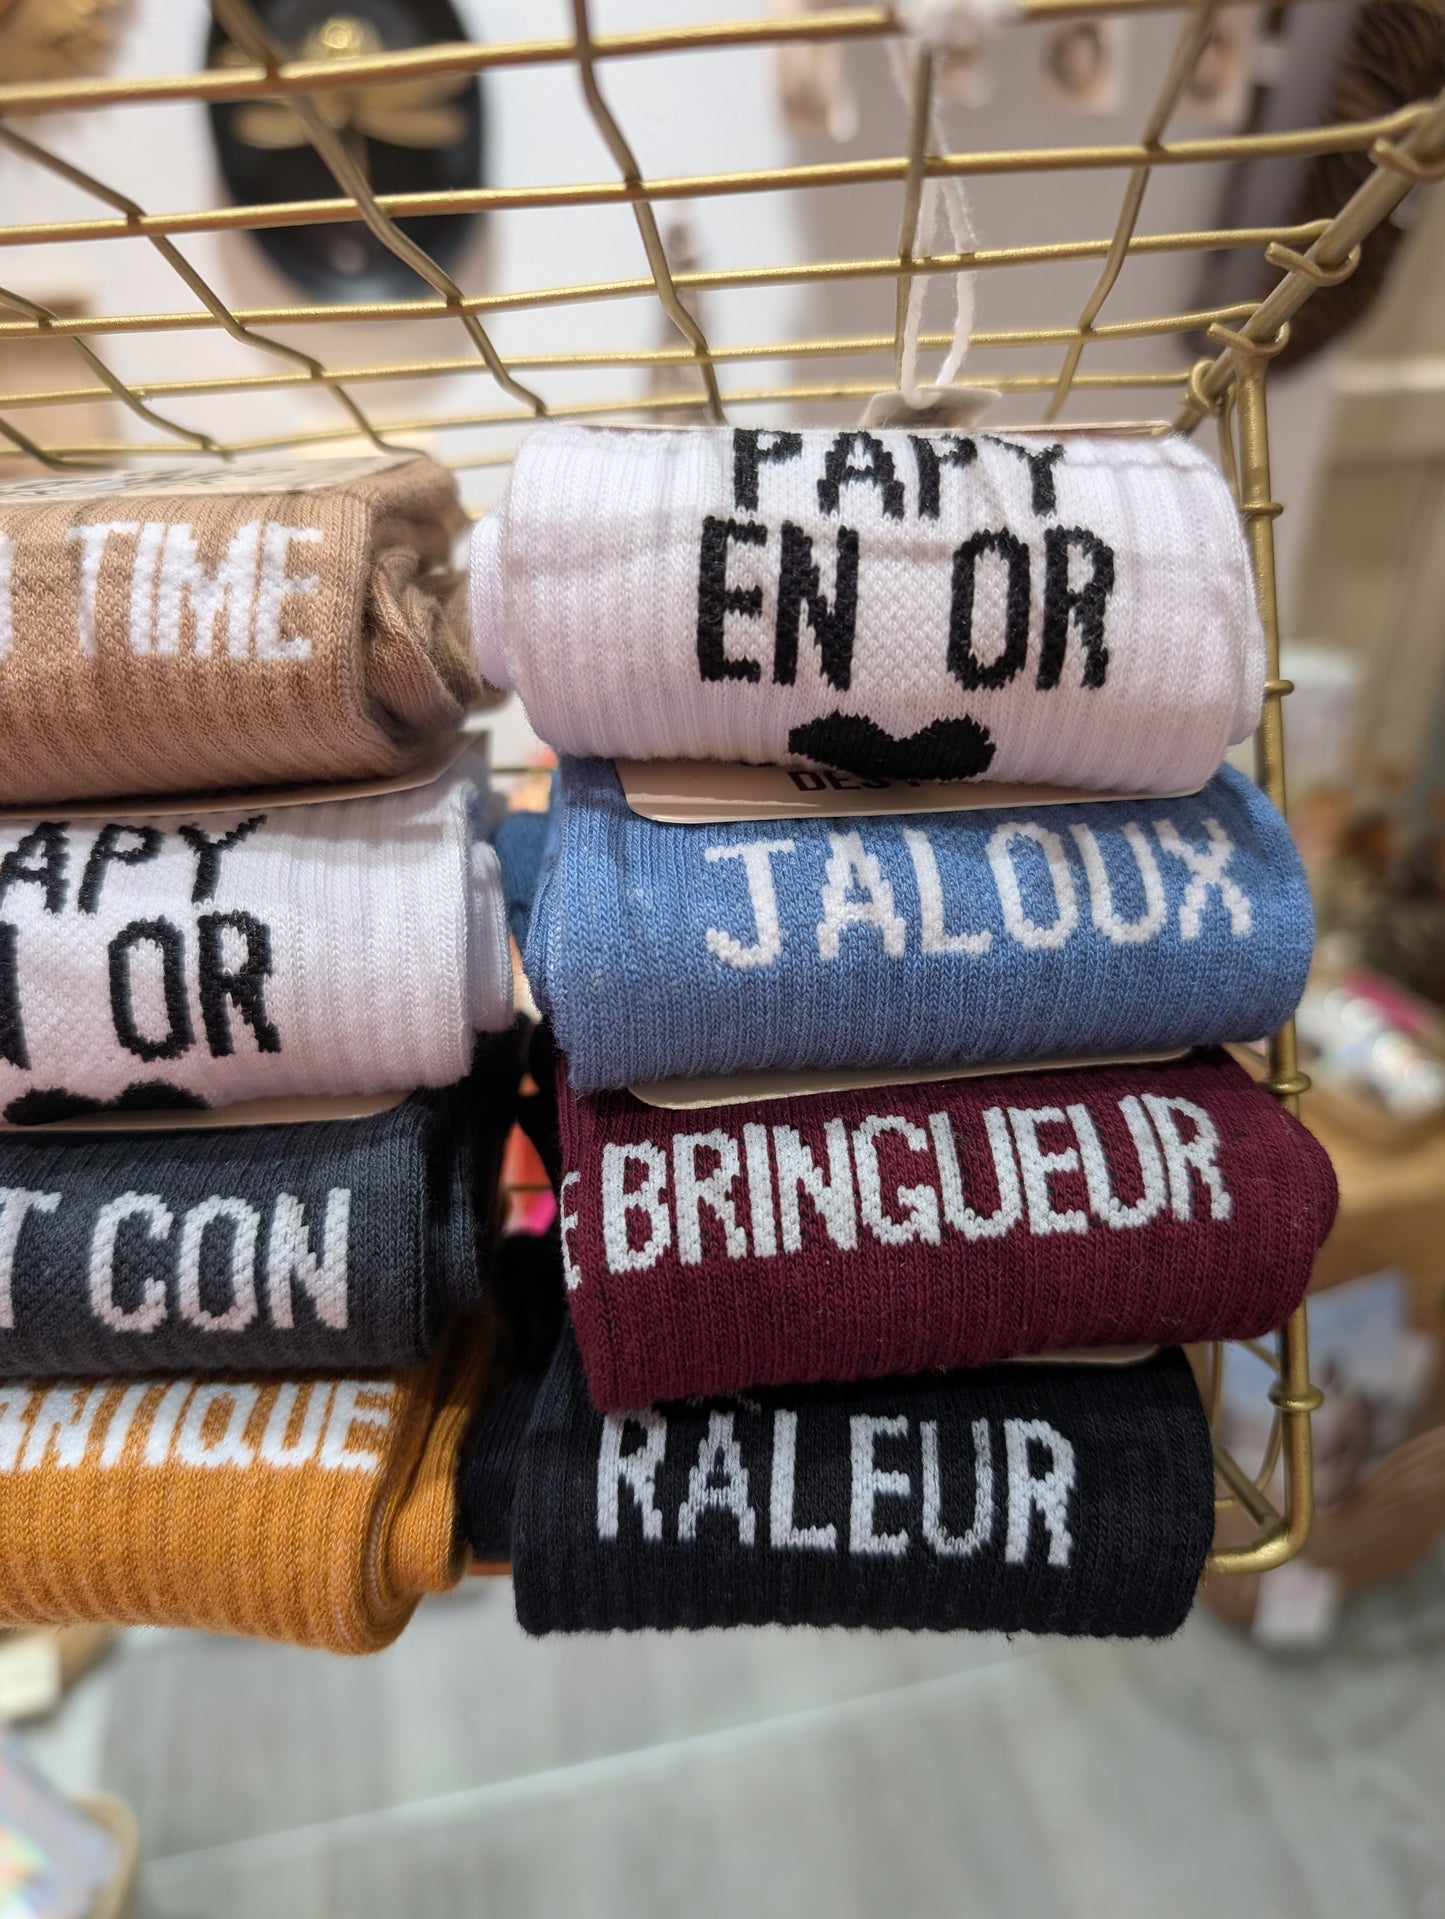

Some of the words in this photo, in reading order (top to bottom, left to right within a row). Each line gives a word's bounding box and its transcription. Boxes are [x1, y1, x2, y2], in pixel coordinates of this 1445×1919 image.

[734, 428, 1065, 520] PAPY
[66, 520, 324, 661] TIME
[697, 517, 860, 691] EN
[946, 526, 1115, 692] OR
[704, 820, 1252, 970] JALOUX
[107, 910, 282, 1062] OR
[90, 1187, 351, 1333] CON
[602, 1094, 1233, 1277] BRINGUEUR
[597, 1405, 1078, 1568] RALEUR
